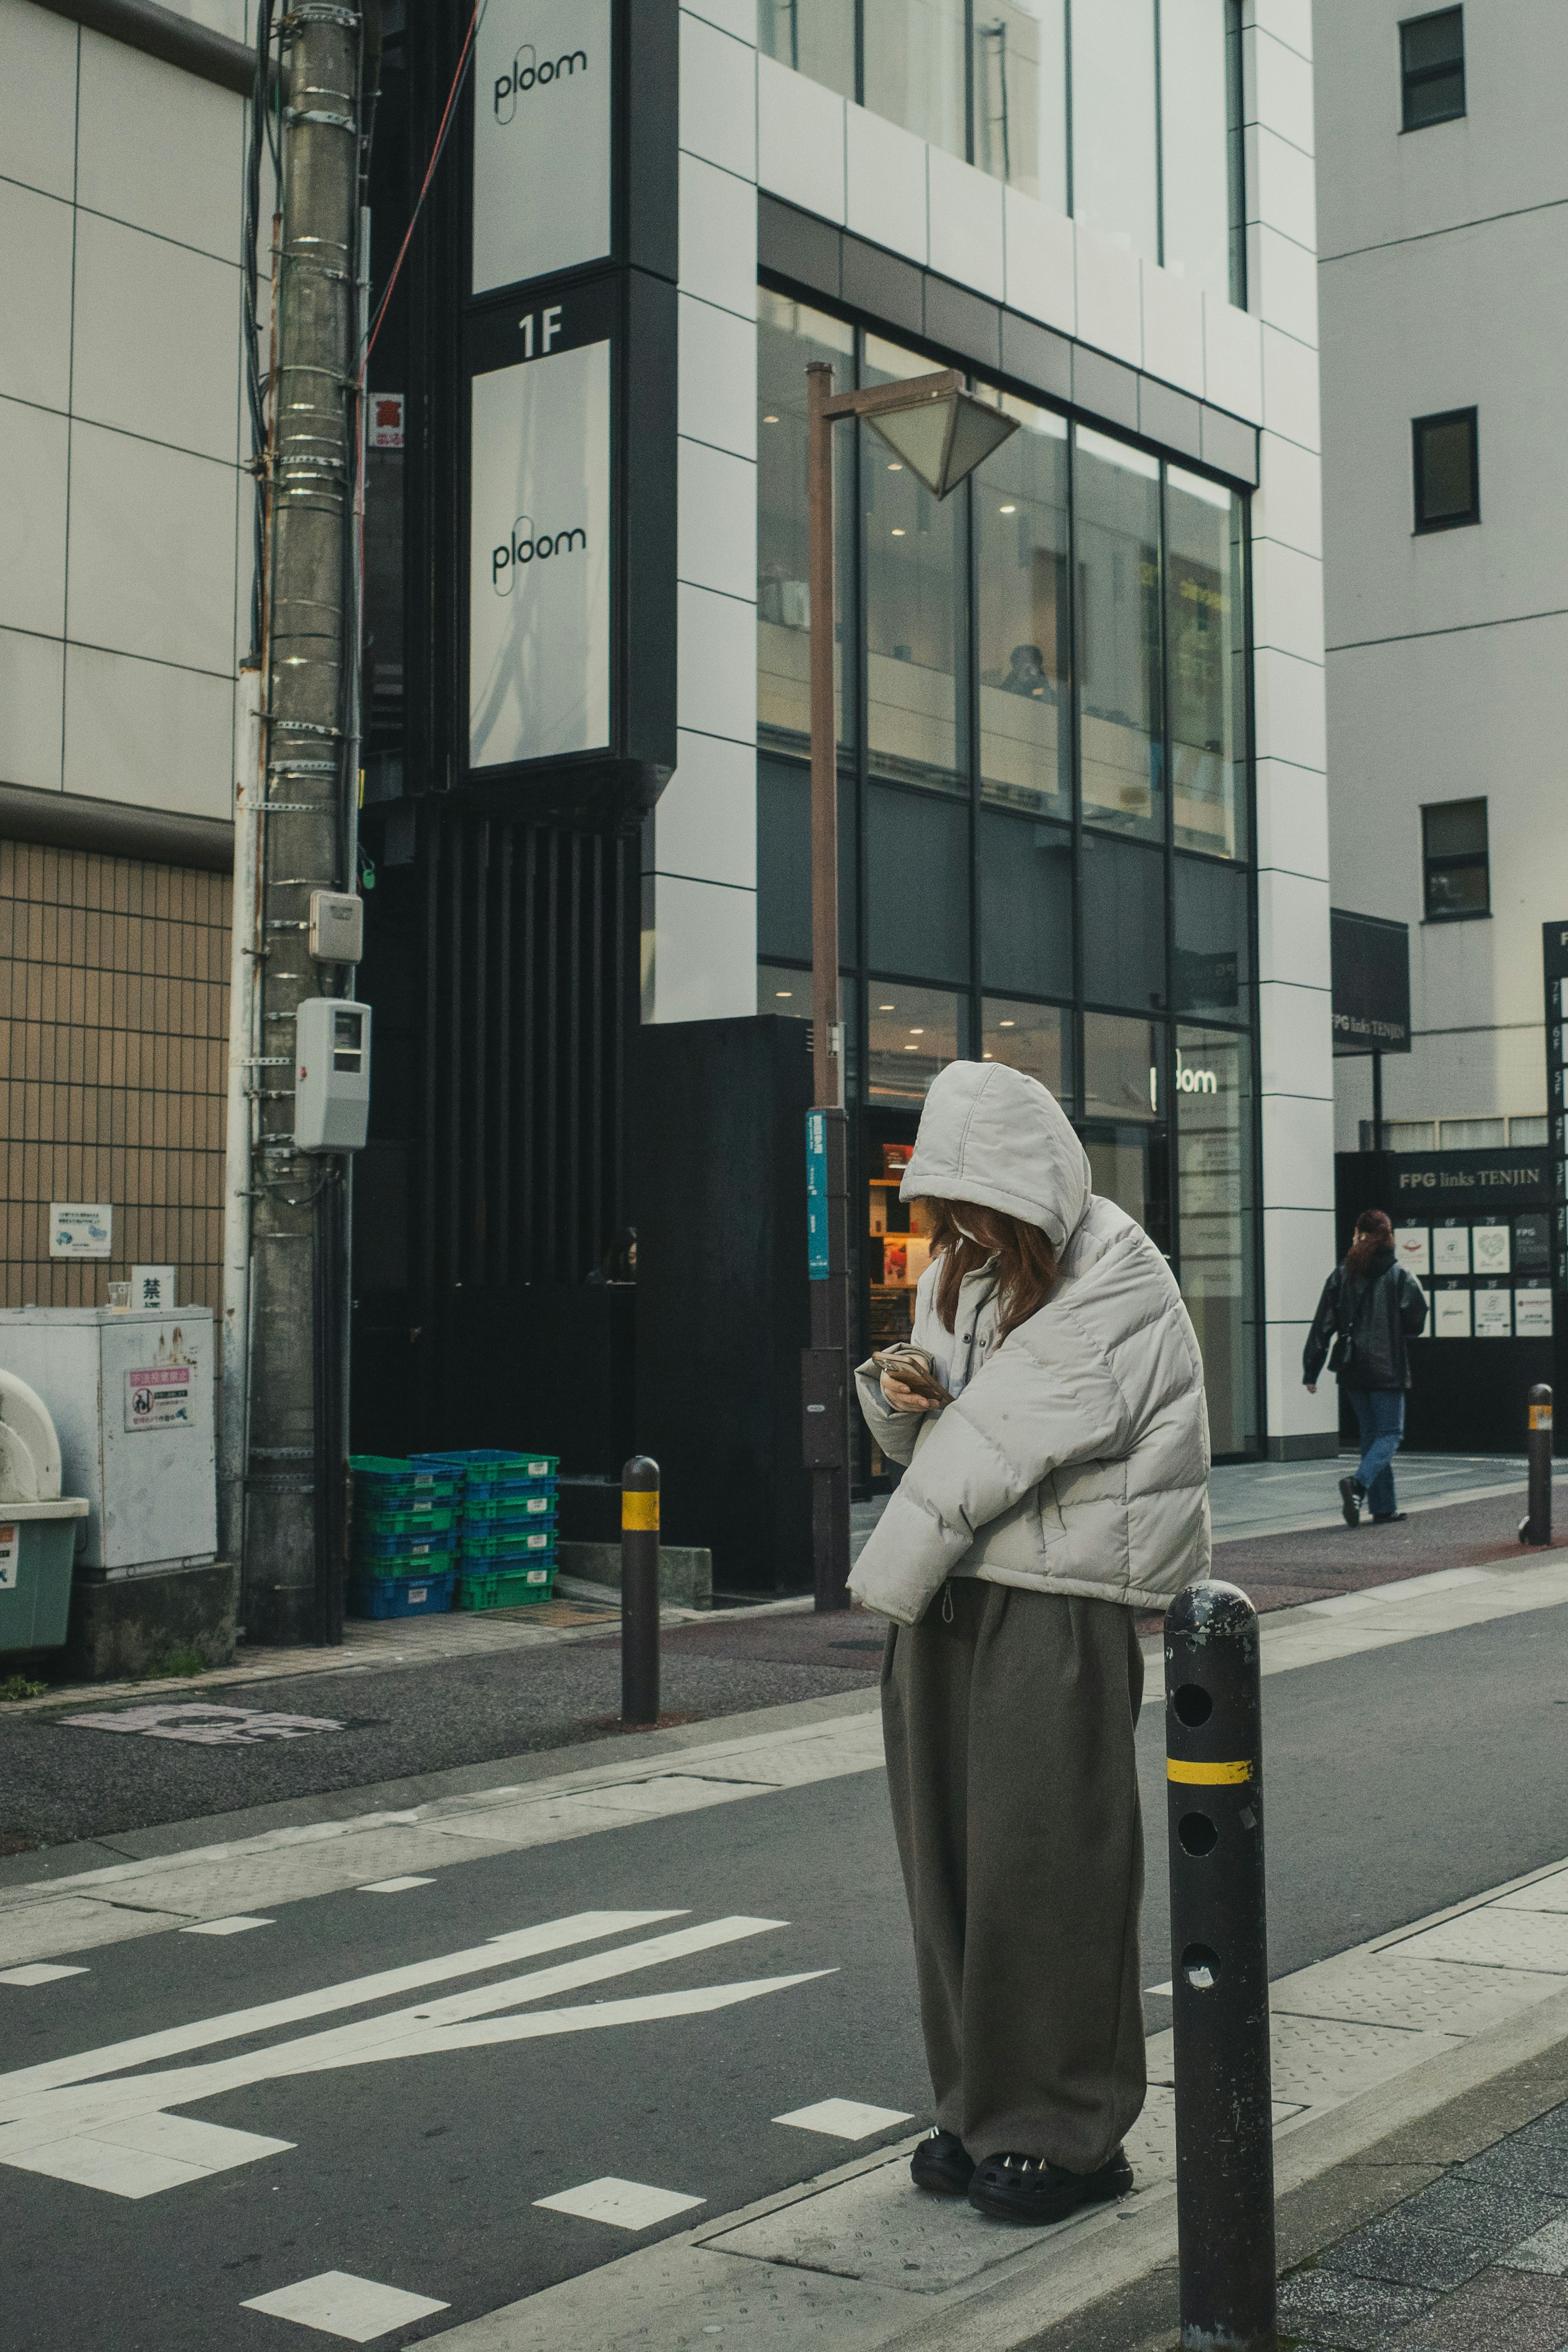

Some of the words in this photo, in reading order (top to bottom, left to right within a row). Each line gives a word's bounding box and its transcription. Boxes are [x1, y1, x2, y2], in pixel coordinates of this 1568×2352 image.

[494, 50, 587, 114] ploom
[519, 305, 563, 359] 1F
[493, 526, 586, 585] ploom
[1332, 1014, 1348, 1030] PG
[1399, 1172, 1437, 1187] FPG
[1440, 1170, 1474, 1187] links
[1476, 1168, 1539, 1186] TENJIN
[143, 1277, 160, 1308] 禁
